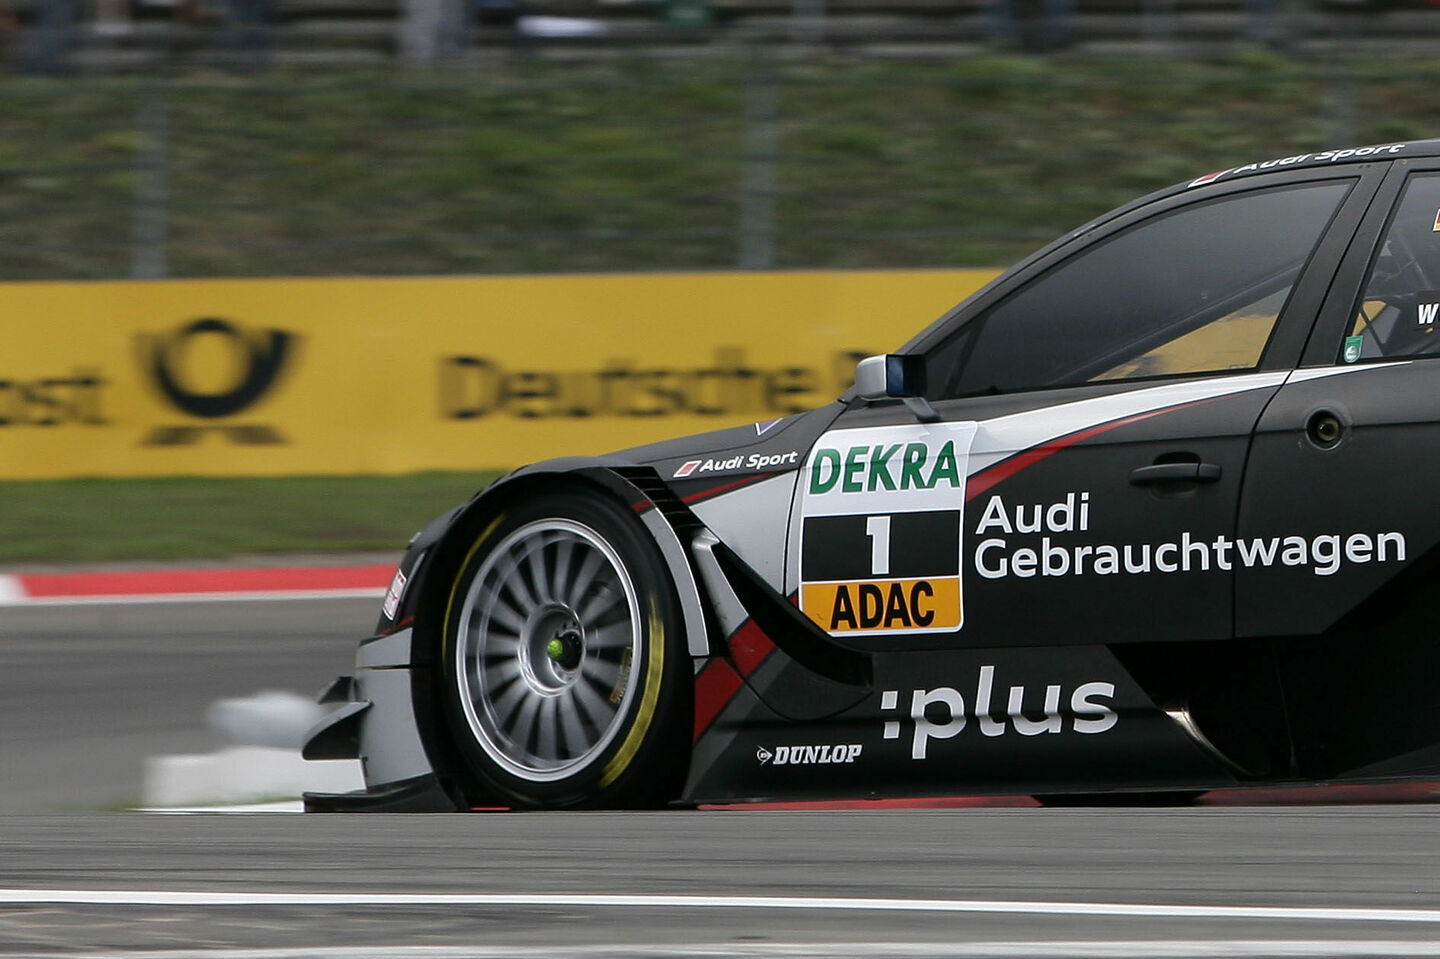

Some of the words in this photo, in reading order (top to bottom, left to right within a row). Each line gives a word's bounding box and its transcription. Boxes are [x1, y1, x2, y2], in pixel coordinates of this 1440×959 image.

[1233, 153, 1312, 174] Audi
[1314, 144, 1405, 162] Sport
[440, 349, 818, 420] Deutsche
[699, 456, 744, 472] Audi
[746, 451, 798, 470] Sport
[809, 439, 961, 495] DEKRA
[975, 492, 1090, 535] Audi
[866, 515, 892, 575] 1
[974, 531, 1407, 579] Gebrauchtwagen
[830, 581, 935, 630] ADAC
[772, 744, 863, 765] DUNLOP
